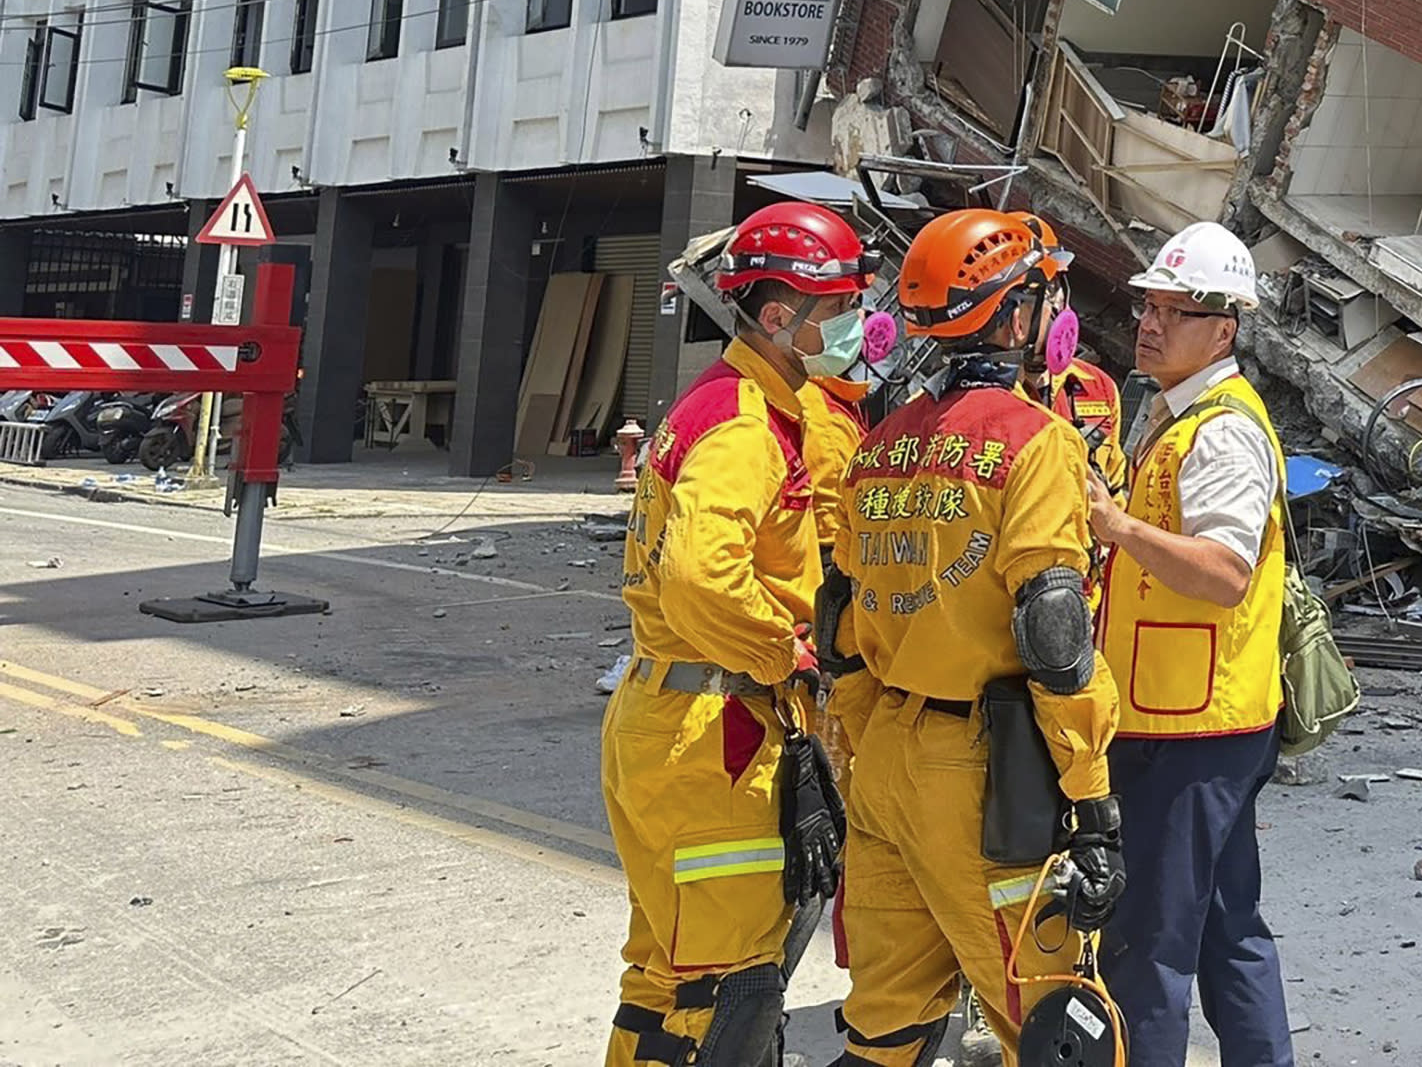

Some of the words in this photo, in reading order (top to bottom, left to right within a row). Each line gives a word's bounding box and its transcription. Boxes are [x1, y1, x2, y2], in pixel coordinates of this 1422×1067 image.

[744, 0, 825, 20] BOOKSTORE
[748, 35, 780, 45] SINCE
[783, 36, 809, 46] 1979
[862, 589, 878, 613] &
[940, 529, 993, 588] TEAM
